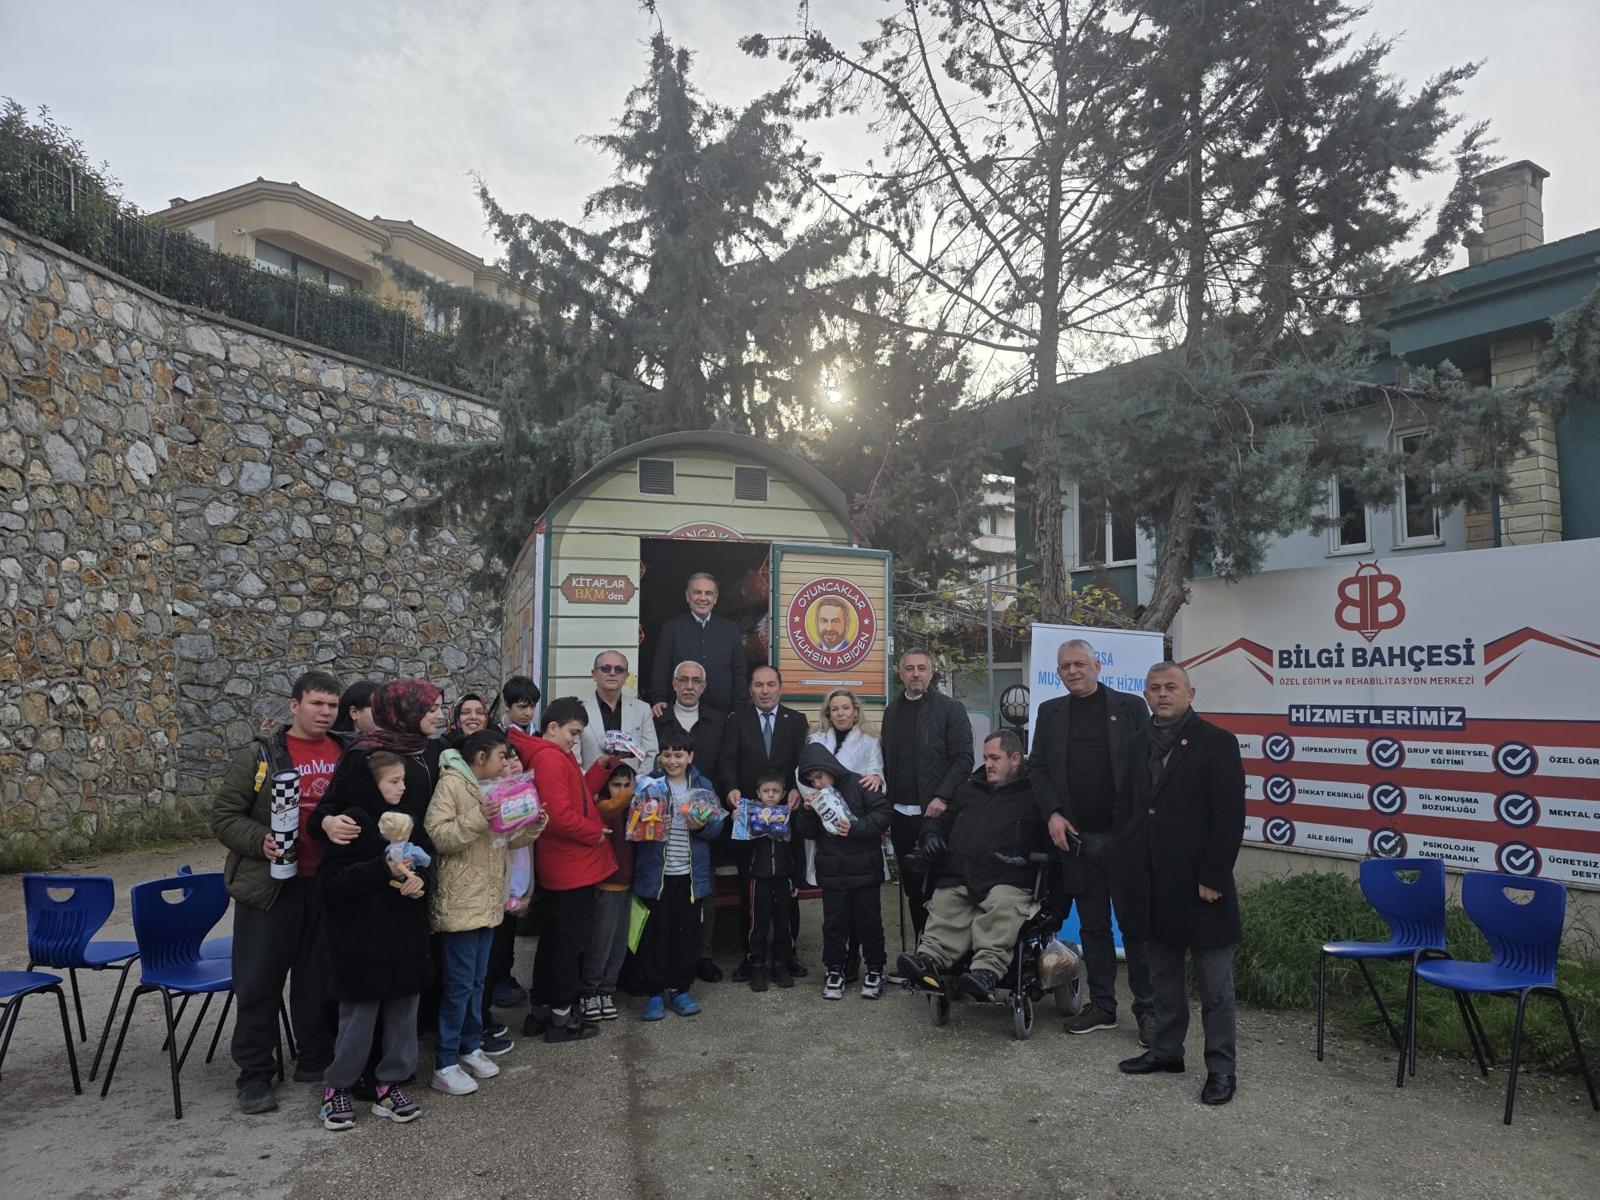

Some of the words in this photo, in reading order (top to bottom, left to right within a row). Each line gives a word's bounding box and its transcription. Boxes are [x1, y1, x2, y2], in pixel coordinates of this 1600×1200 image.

[572, 576, 625, 589] KİTAPLAR
[798, 582, 866, 610] OYUNCAKLAR
[1094, 651, 1114, 666] RSA
[1278, 642, 1345, 669] BİLGİ
[1351, 637, 1476, 672] BAHÇESİ
[1038, 670, 1060, 690] MUŞ
[1117, 673, 1146, 692] HİZM
[1279, 677, 1300, 686] ÖZEL
[1302, 677, 1331, 686] EĞİTİM
[1345, 676, 1427, 686] REHABİLİTASYON
[1429, 675, 1475, 685] MERKEZİ
[1291, 705, 1463, 726] HİZMETLERİMİZ
[1302, 746, 1358, 755] HİPERAKTİVİTE
[1446, 748, 1489, 757] BİREYSEL
[1430, 758, 1464, 766] EĞİTİMİ
[1549, 756, 1575, 764] ÖZEL
[1298, 788, 1325, 797] DİKKAT
[1418, 793, 1433, 801] DİL
[1434, 795, 1480, 805] KONUŞMA
[1421, 803, 1476, 814] BOZUKLUĞU
[1549, 809, 1590, 819] MENTAL
[1306, 832, 1323, 841] AİLE
[1423, 841, 1476, 853] PSİKOLOJİK
[1548, 855, 1599, 868] ÜCRETSİZ
[1571, 870, 1600, 879] DEST
